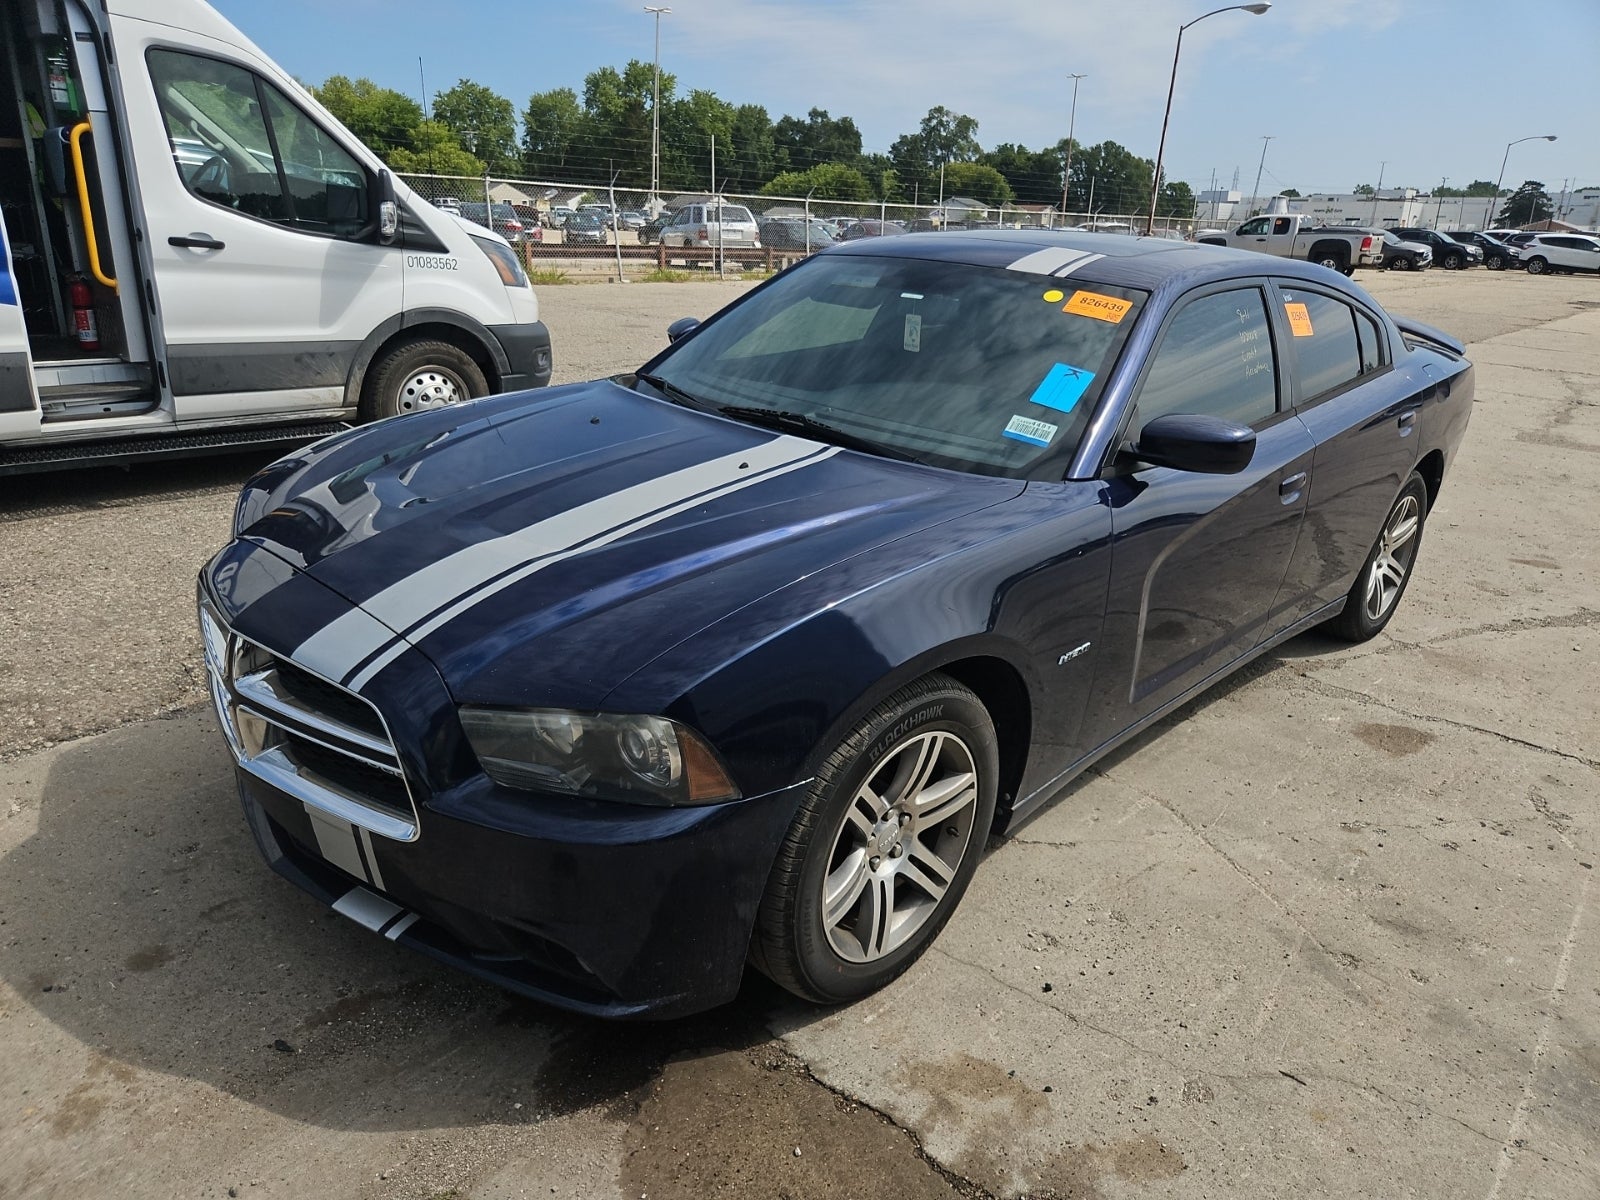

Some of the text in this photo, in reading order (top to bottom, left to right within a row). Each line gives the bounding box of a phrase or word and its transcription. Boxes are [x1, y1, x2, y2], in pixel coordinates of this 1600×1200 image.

[407, 255, 458, 271] 01083562
[1079, 296, 1124, 312] 826439
[868, 704, 944, 763] BLACKHAWK
